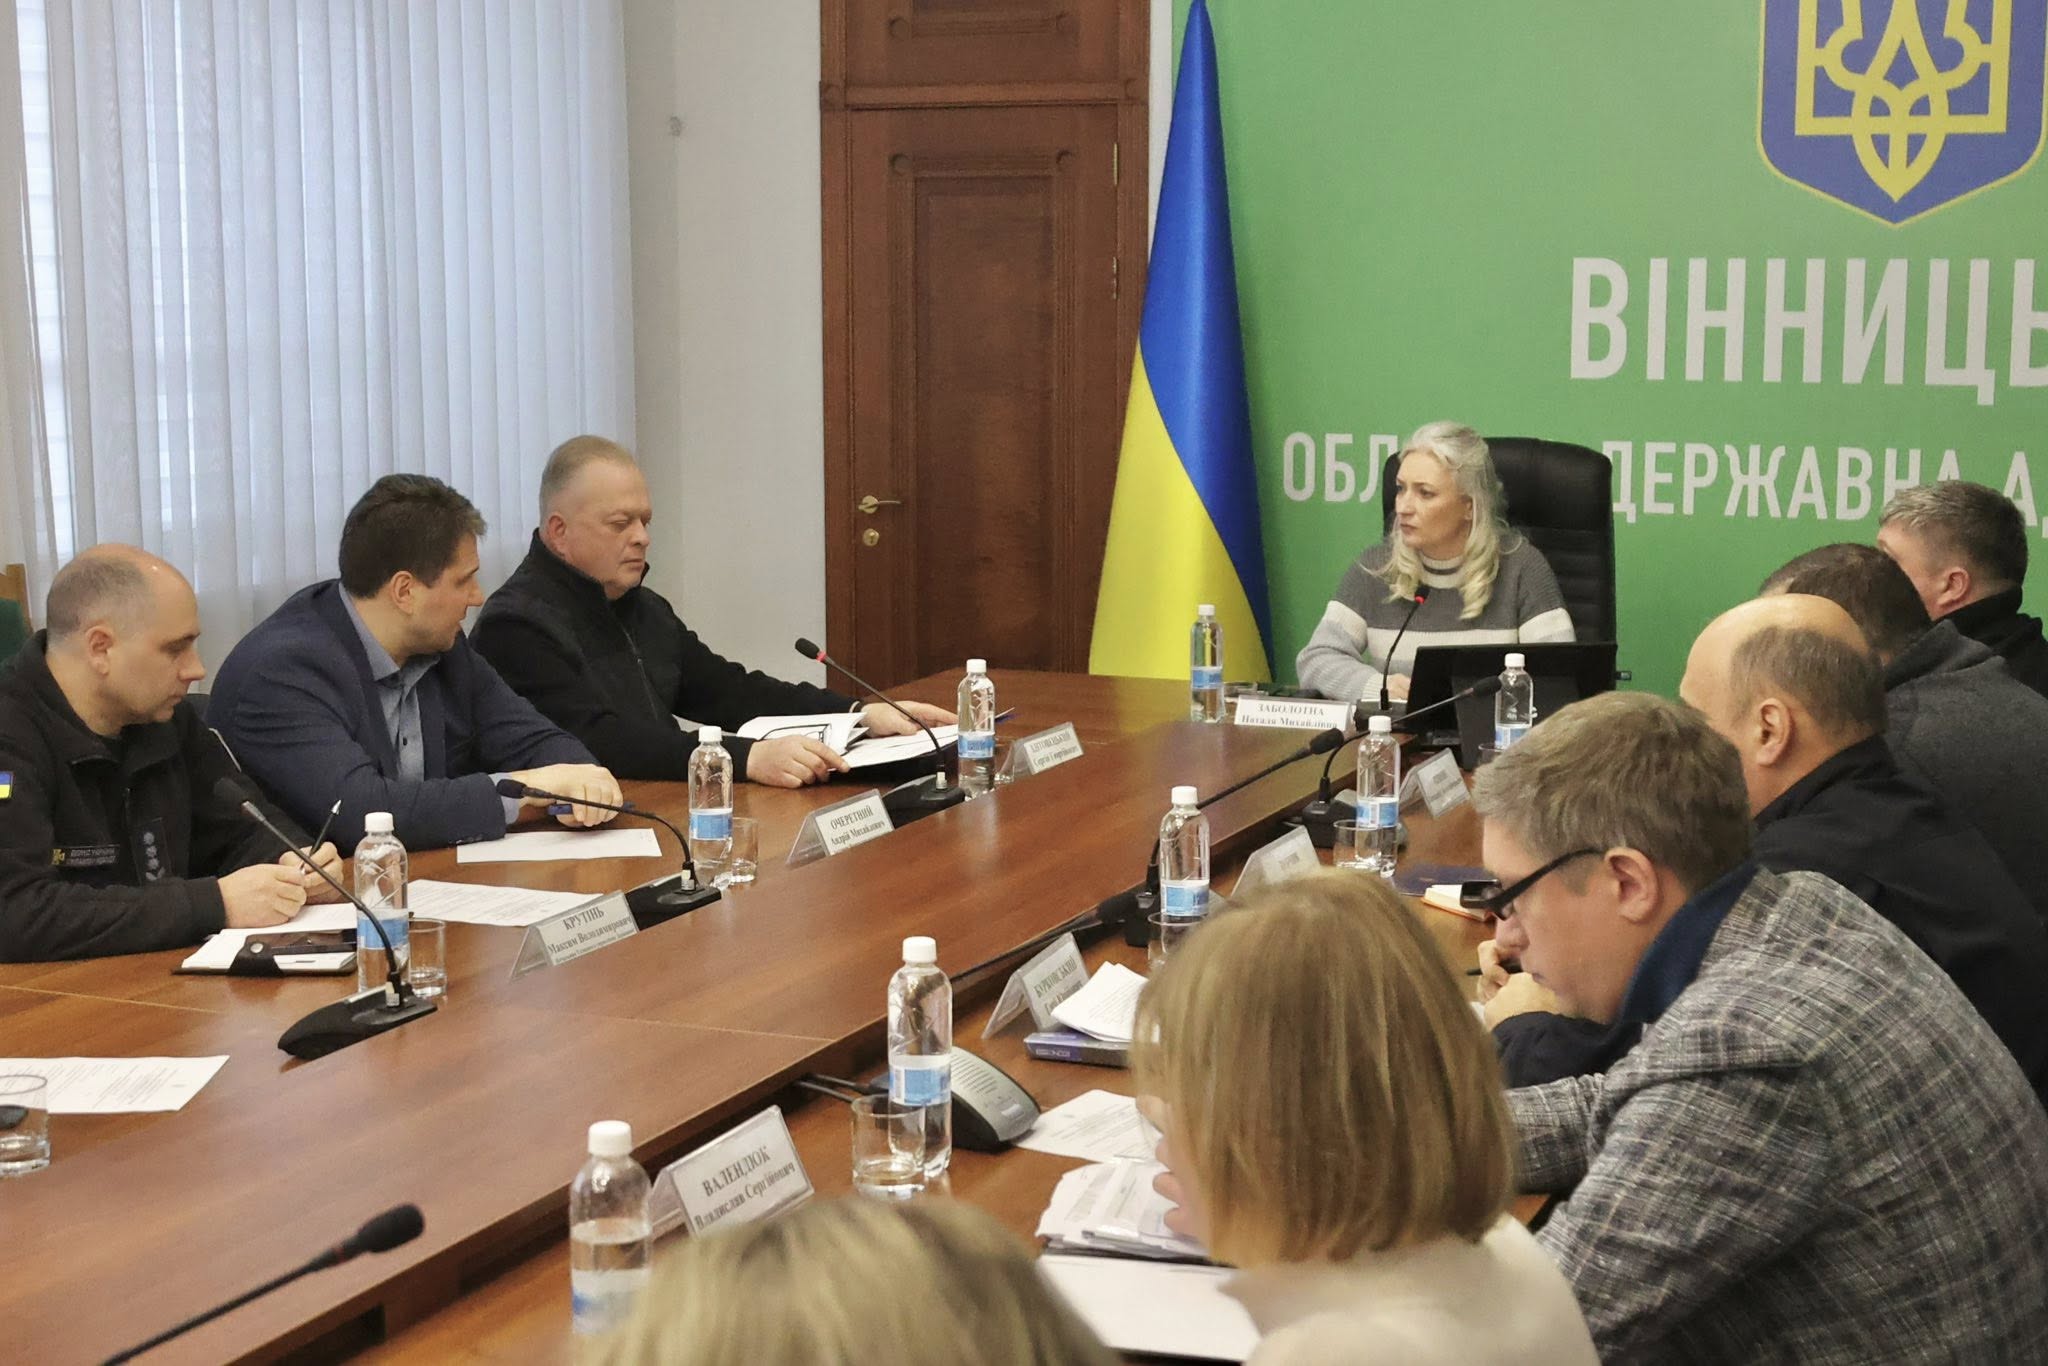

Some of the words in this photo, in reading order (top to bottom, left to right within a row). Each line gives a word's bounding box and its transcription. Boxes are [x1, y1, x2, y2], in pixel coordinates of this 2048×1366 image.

[1571, 257, 2048, 405] ВІННИЦЬ
[2003, 451, 2048, 538] А
[830, 804, 874, 830] ОЧЕРЕТНИЙ
[563, 906, 605, 931] КРУТІНЬ
[547, 939, 579, 955] Максим
[702, 1145, 771, 1198] ВАЛЕНДЮК
